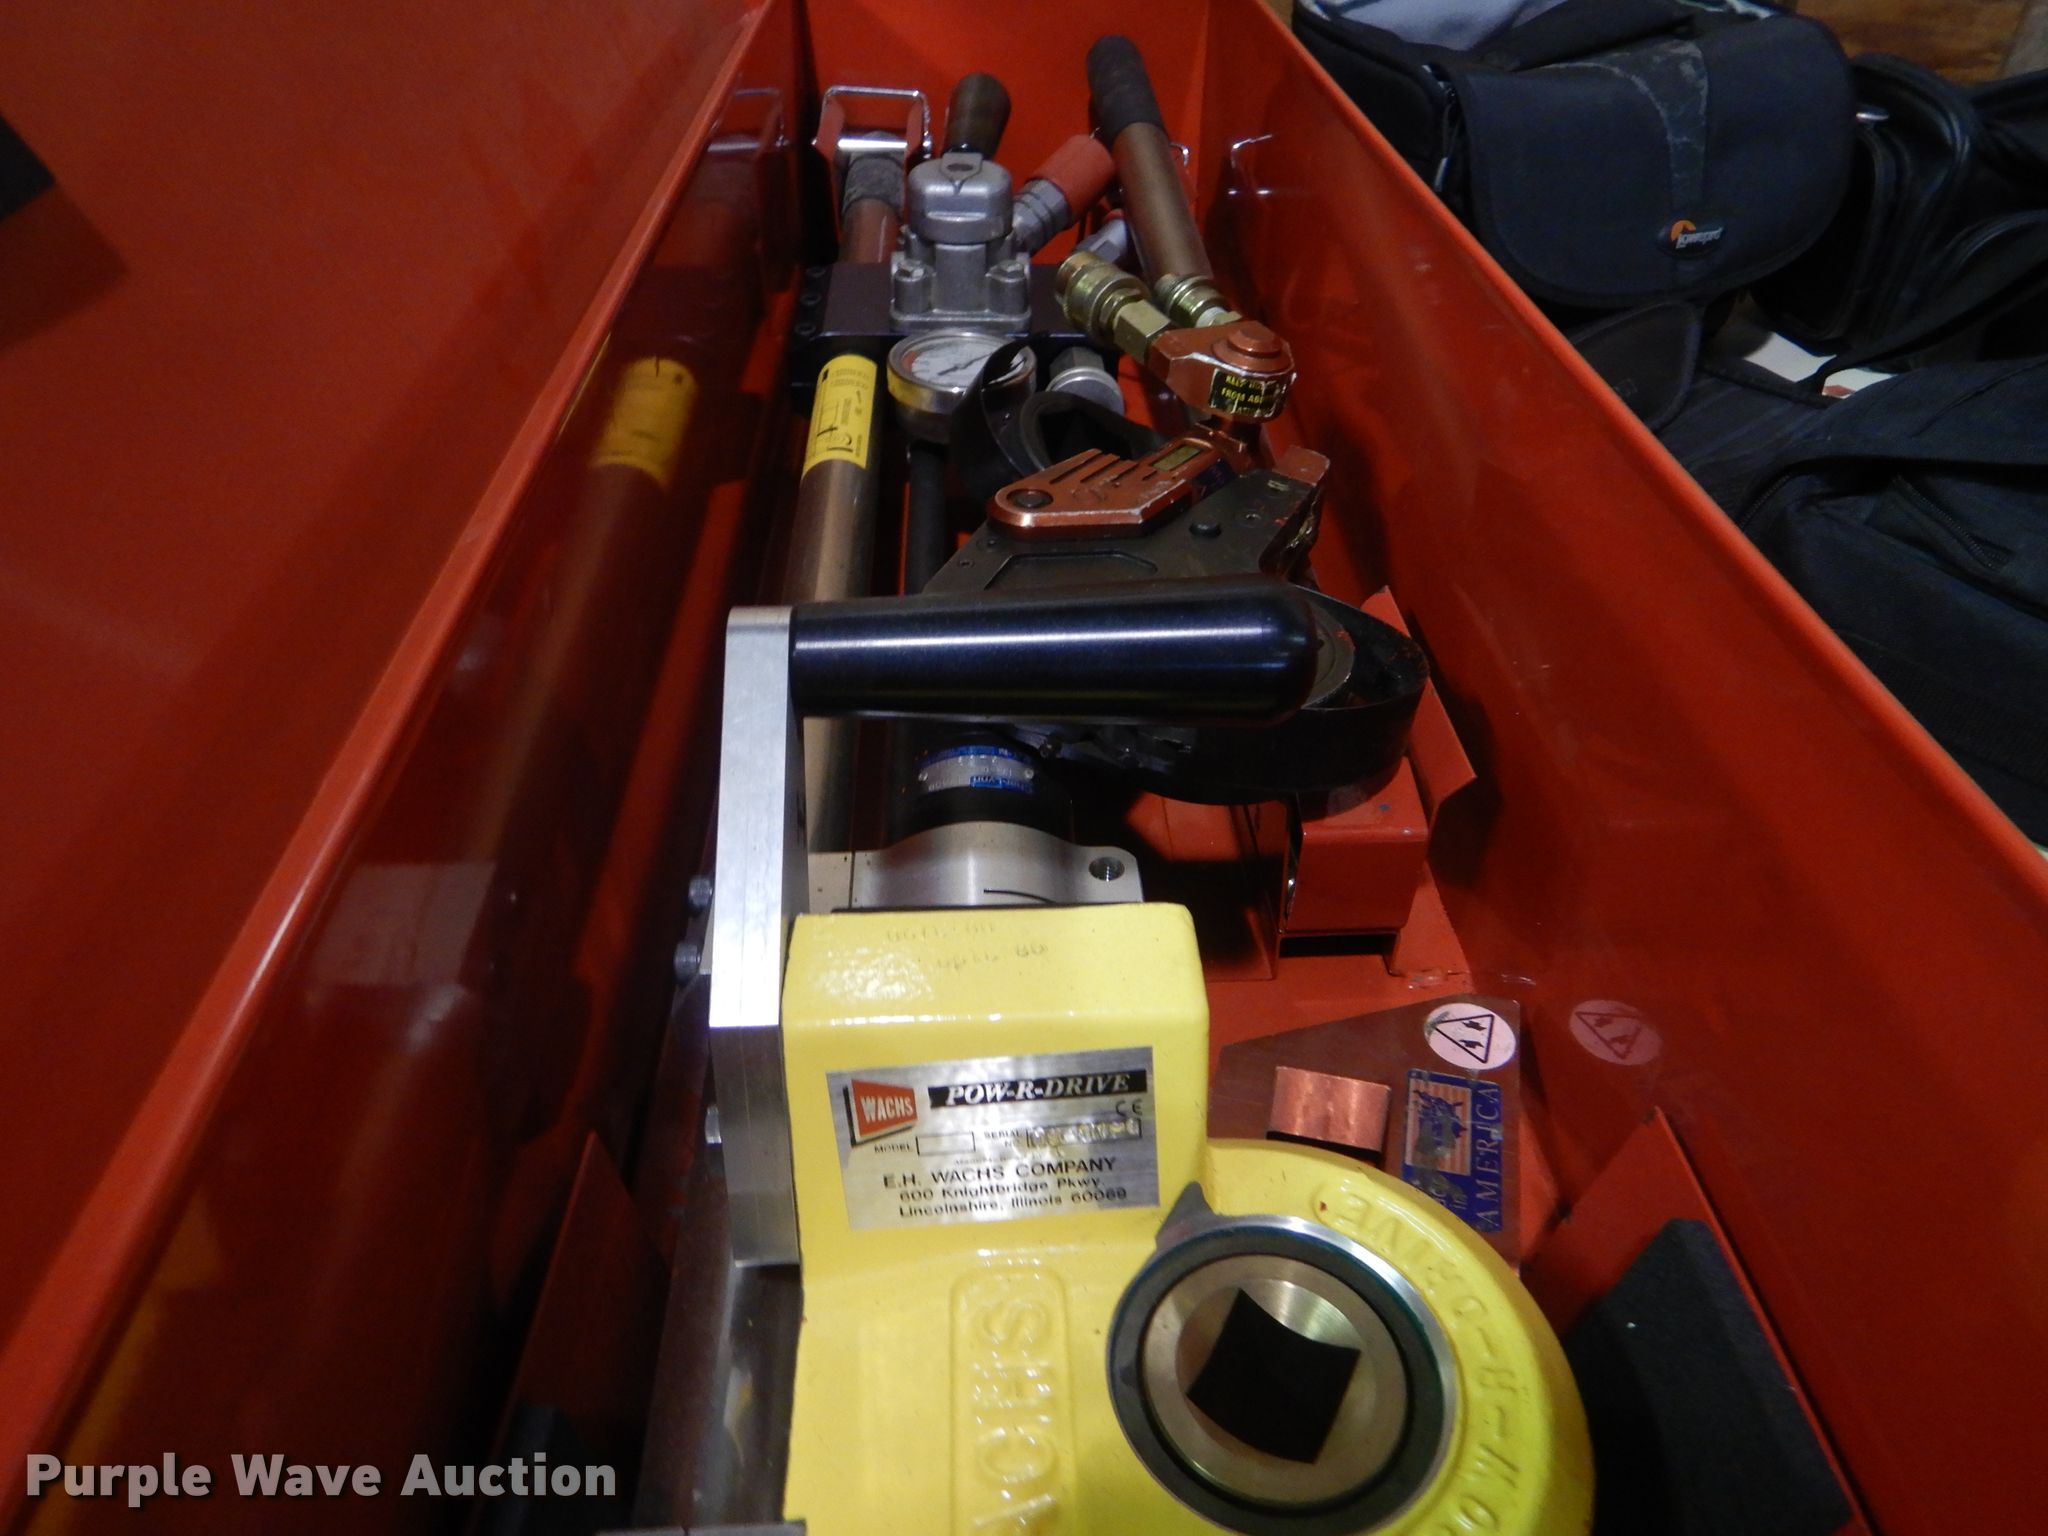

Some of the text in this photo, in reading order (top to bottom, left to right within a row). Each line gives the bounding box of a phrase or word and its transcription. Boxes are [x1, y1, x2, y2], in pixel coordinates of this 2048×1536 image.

[945, 1073, 1131, 1106] POW-R-DRIVE
[860, 1093, 915, 1122] WACHS
[874, 1142, 914, 1154] MODEL
[1476, 1086, 1500, 1228] AMERICA
[883, 1172, 922, 1188] E.H.
[931, 1166, 1006, 1185] WACHS
[1015, 1157, 1117, 1179] COMPANY
[942, 1180, 1049, 1201] Knightbridge
[1011, 1193, 1062, 1210] Illinois
